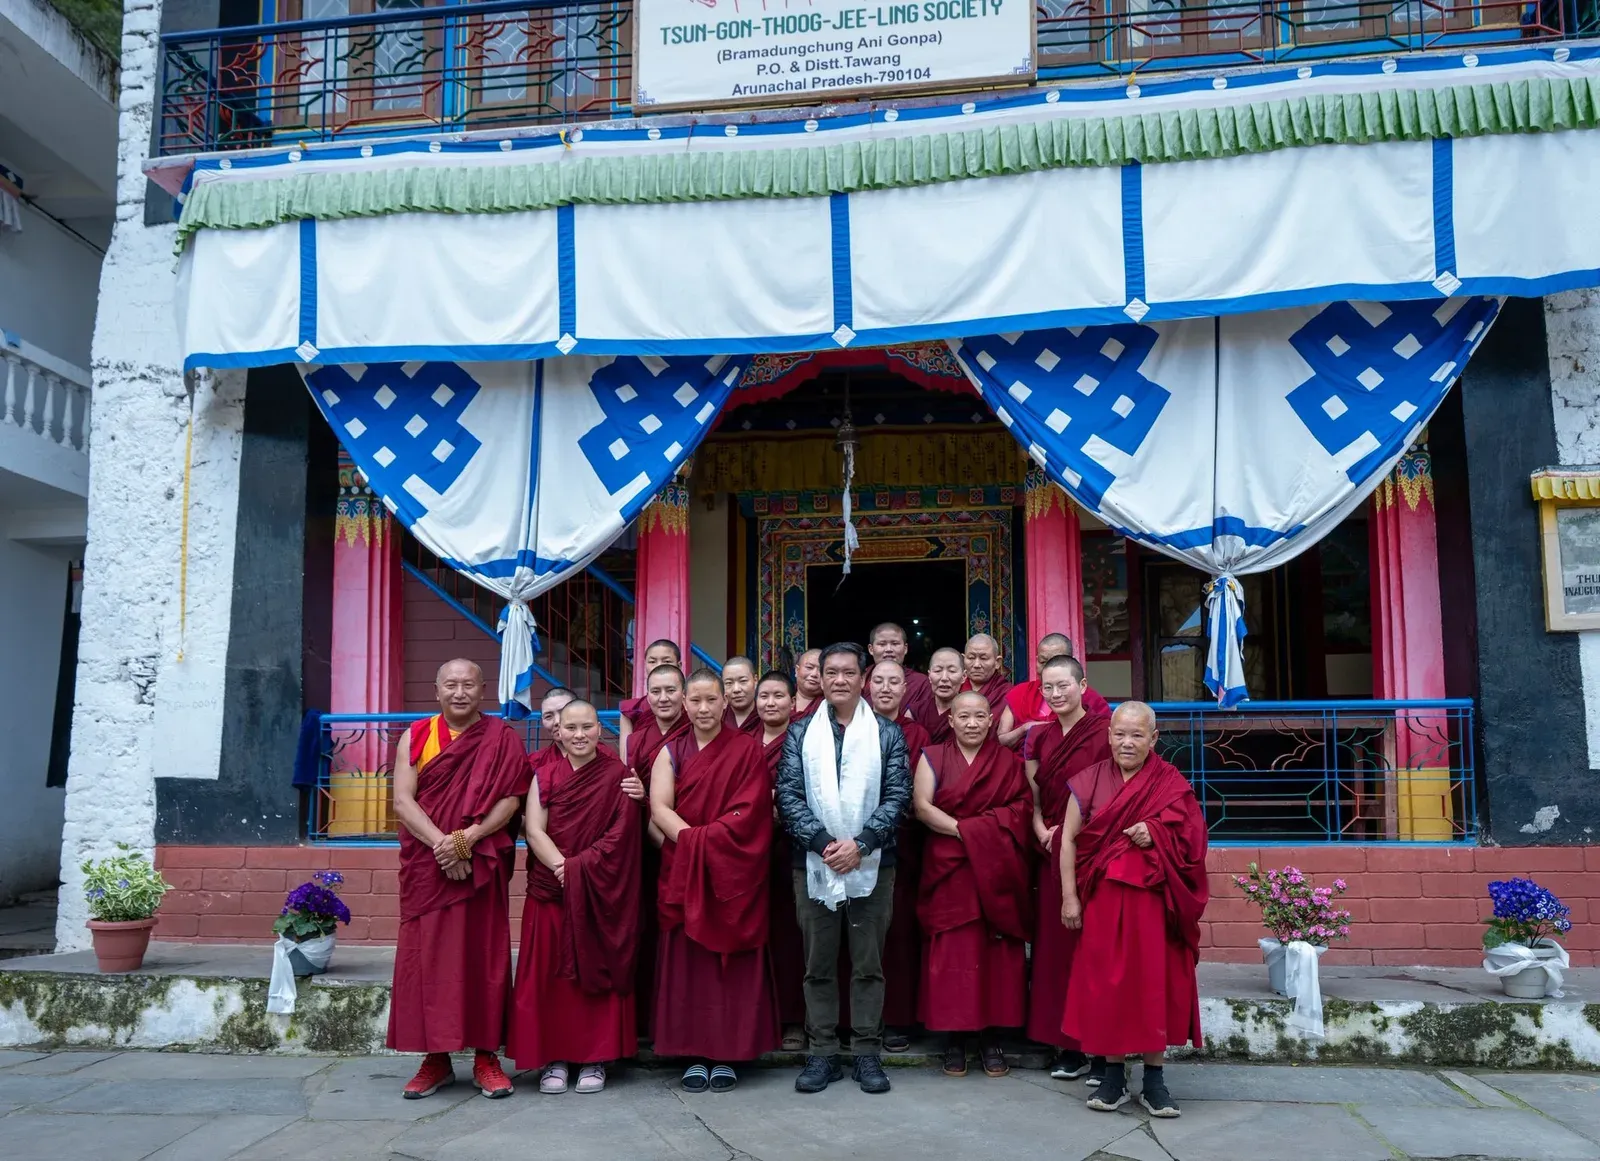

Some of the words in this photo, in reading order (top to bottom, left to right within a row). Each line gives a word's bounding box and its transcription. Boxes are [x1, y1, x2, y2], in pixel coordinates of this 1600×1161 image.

[660, 3, 919, 45] TSUN-GON-THOOG-JEE-LING
[923, 0, 1004, 22] SOCIETY
[717, 40, 853, 64] (Bramadungchung
[857, 35, 882, 49] Ani
[887, 30, 942, 46] Gonpa)
[756, 62, 785, 76] P.O.
[790, 61, 800, 73] &
[805, 54, 901, 72] Distt.Tawang
[731, 77, 806, 96] Arunachal
[811, 67, 931, 89] Pradesh-790104
